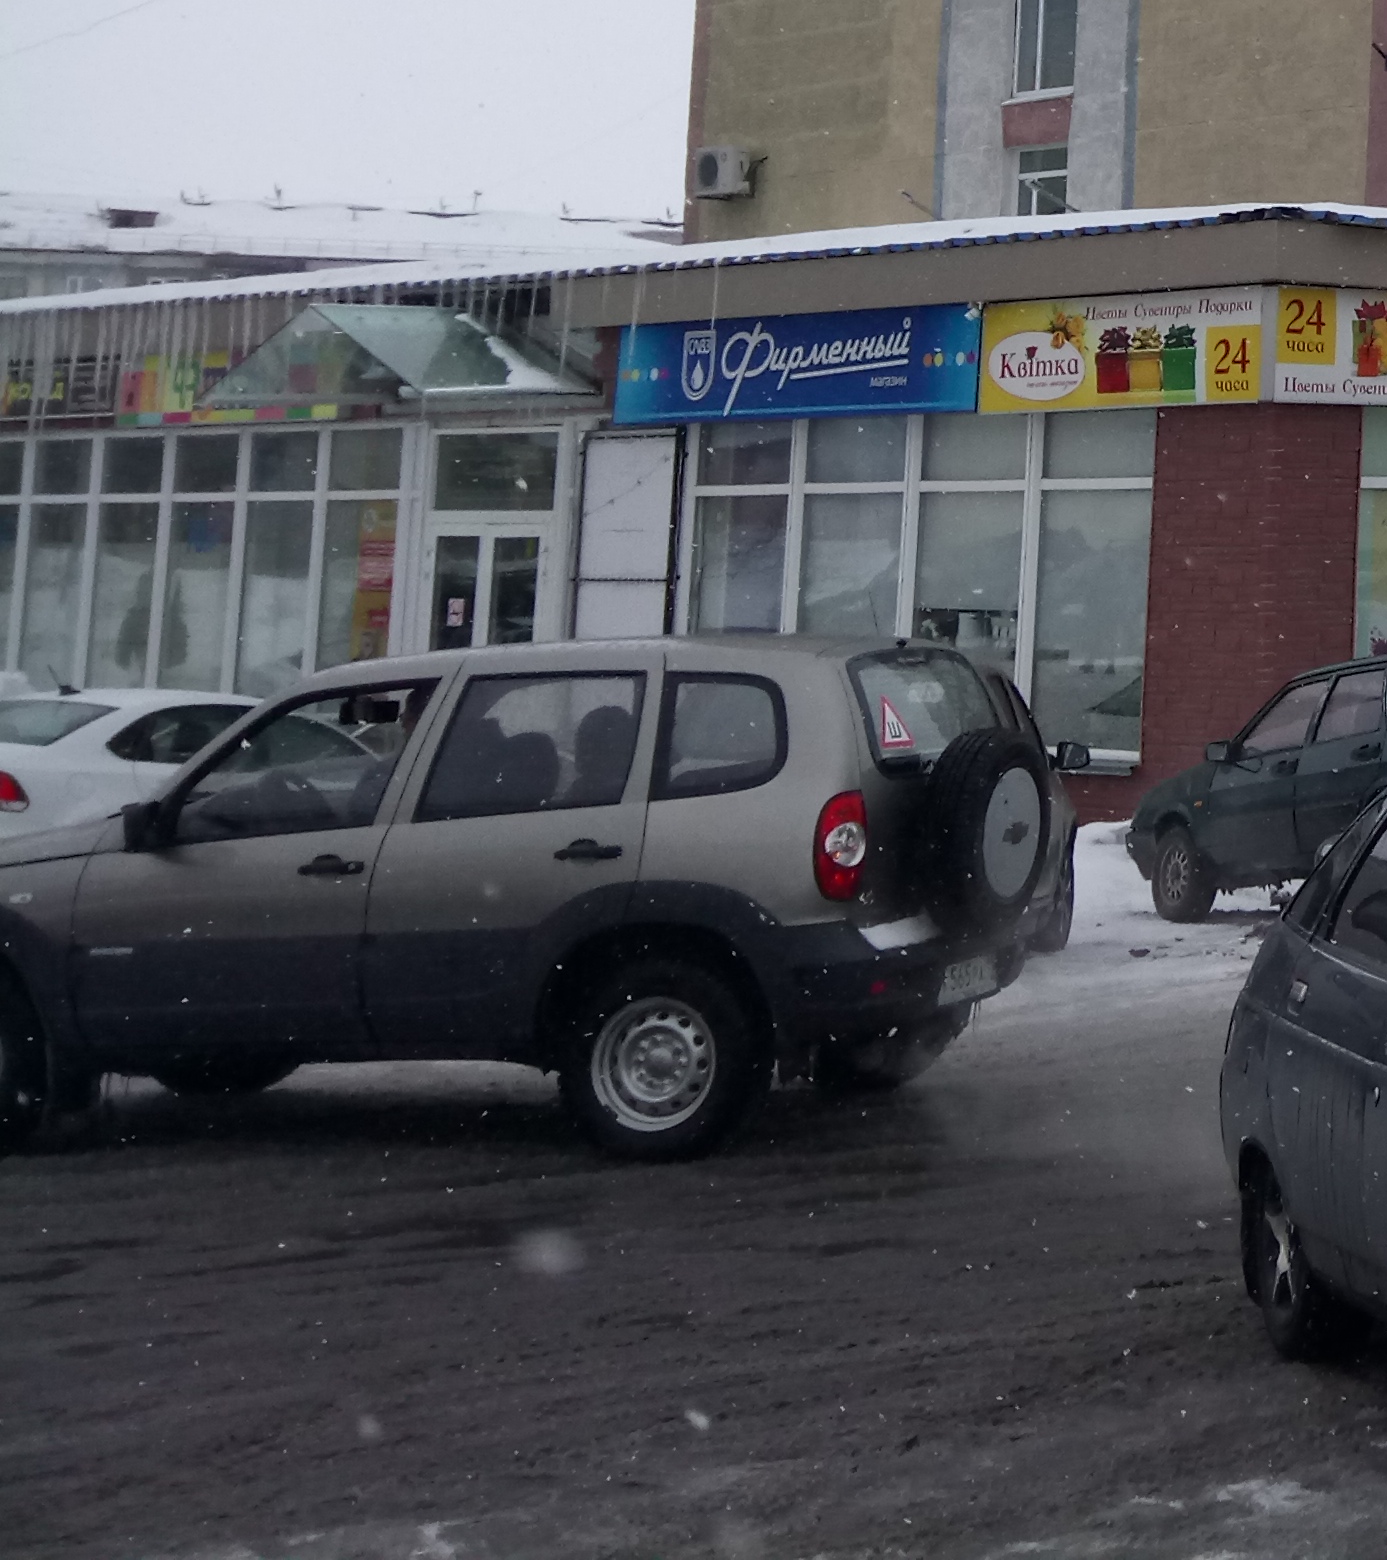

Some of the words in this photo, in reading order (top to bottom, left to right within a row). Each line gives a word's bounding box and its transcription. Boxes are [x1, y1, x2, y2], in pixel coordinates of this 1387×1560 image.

[1134, 303, 1192, 321] Сувениры
[1198, 298, 1253, 316] Подарки
[1285, 298, 1326, 336] 24
[1213, 337, 1250, 375] 24
[1286, 339, 1325, 354] часа
[721, 317, 912, 417] Фирменный
[869, 375, 907, 388] магазин
[1214, 379, 1250, 393] часа
[1284, 376, 1335, 394] Цветы
[887, 720, 902, 739] Ш
